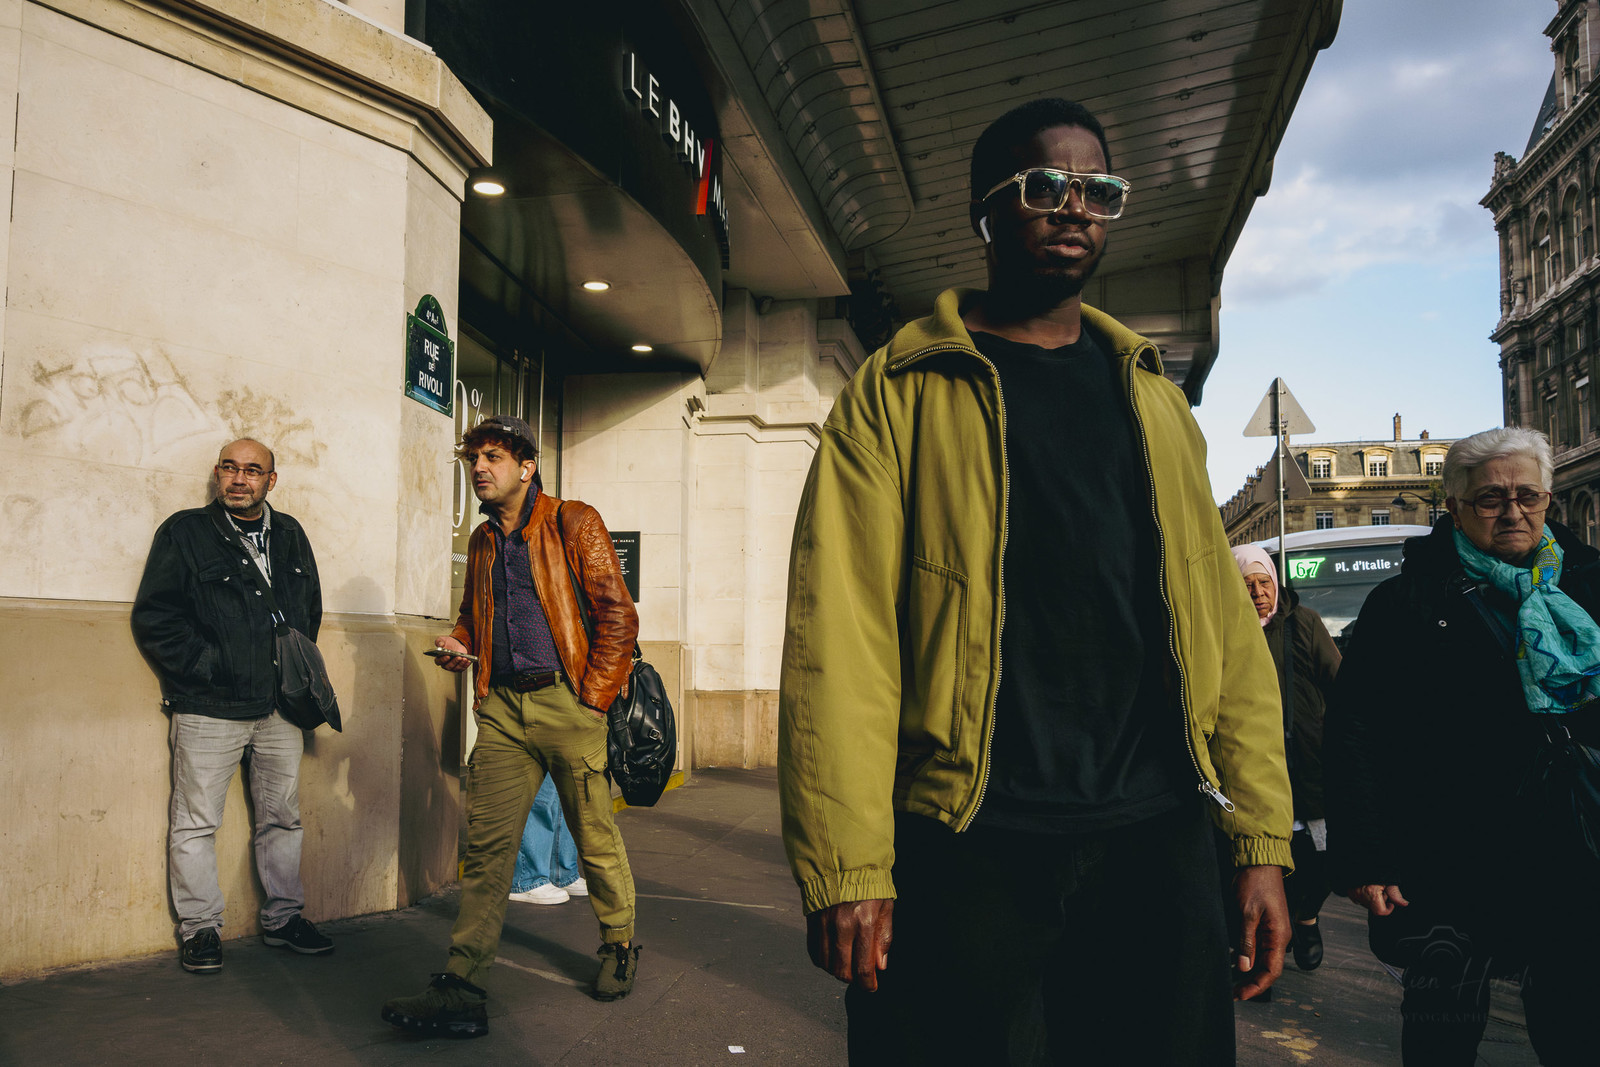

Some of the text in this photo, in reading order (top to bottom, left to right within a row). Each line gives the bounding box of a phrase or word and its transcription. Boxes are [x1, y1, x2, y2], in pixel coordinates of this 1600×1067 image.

[631, 52, 660, 118] LE
[669, 98, 705, 178] BHV
[424, 338, 440, 361] RUE
[428, 361, 435, 372] DE
[418, 370, 443, 397] RIVOLI
[1296, 561, 1320, 578] 67
[1335, 562, 1350, 573] Pl.
[1352, 558, 1391, 571] d'Italie
